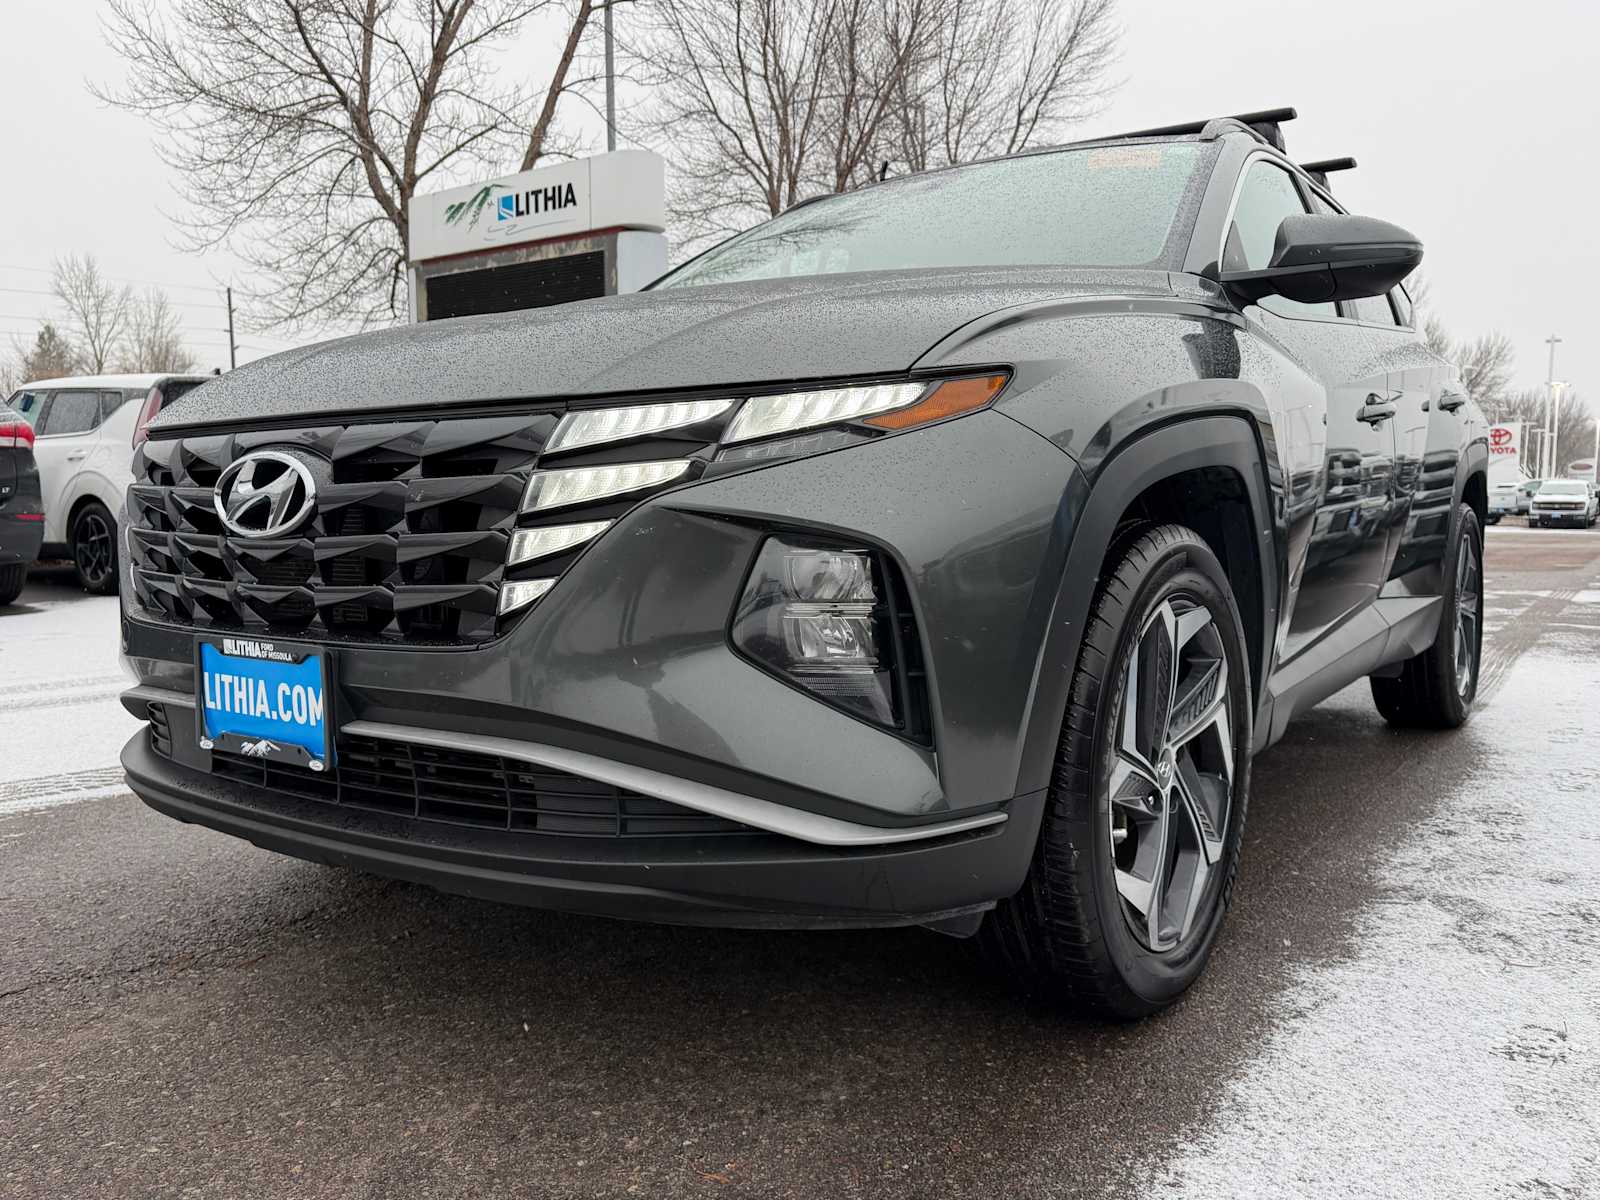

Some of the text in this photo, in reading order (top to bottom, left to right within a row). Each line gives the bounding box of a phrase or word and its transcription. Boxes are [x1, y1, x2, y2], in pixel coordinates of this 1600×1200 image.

[516, 182, 577, 217] LITHIA
[1489, 447, 1517, 455] YOTA
[232, 639, 262, 658] LITHIA
[261, 642, 274, 652] FORD
[262, 650, 268, 658] OF
[268, 651, 293, 662] MISSOULA
[203, 671, 324, 727] LITHIA.COM
